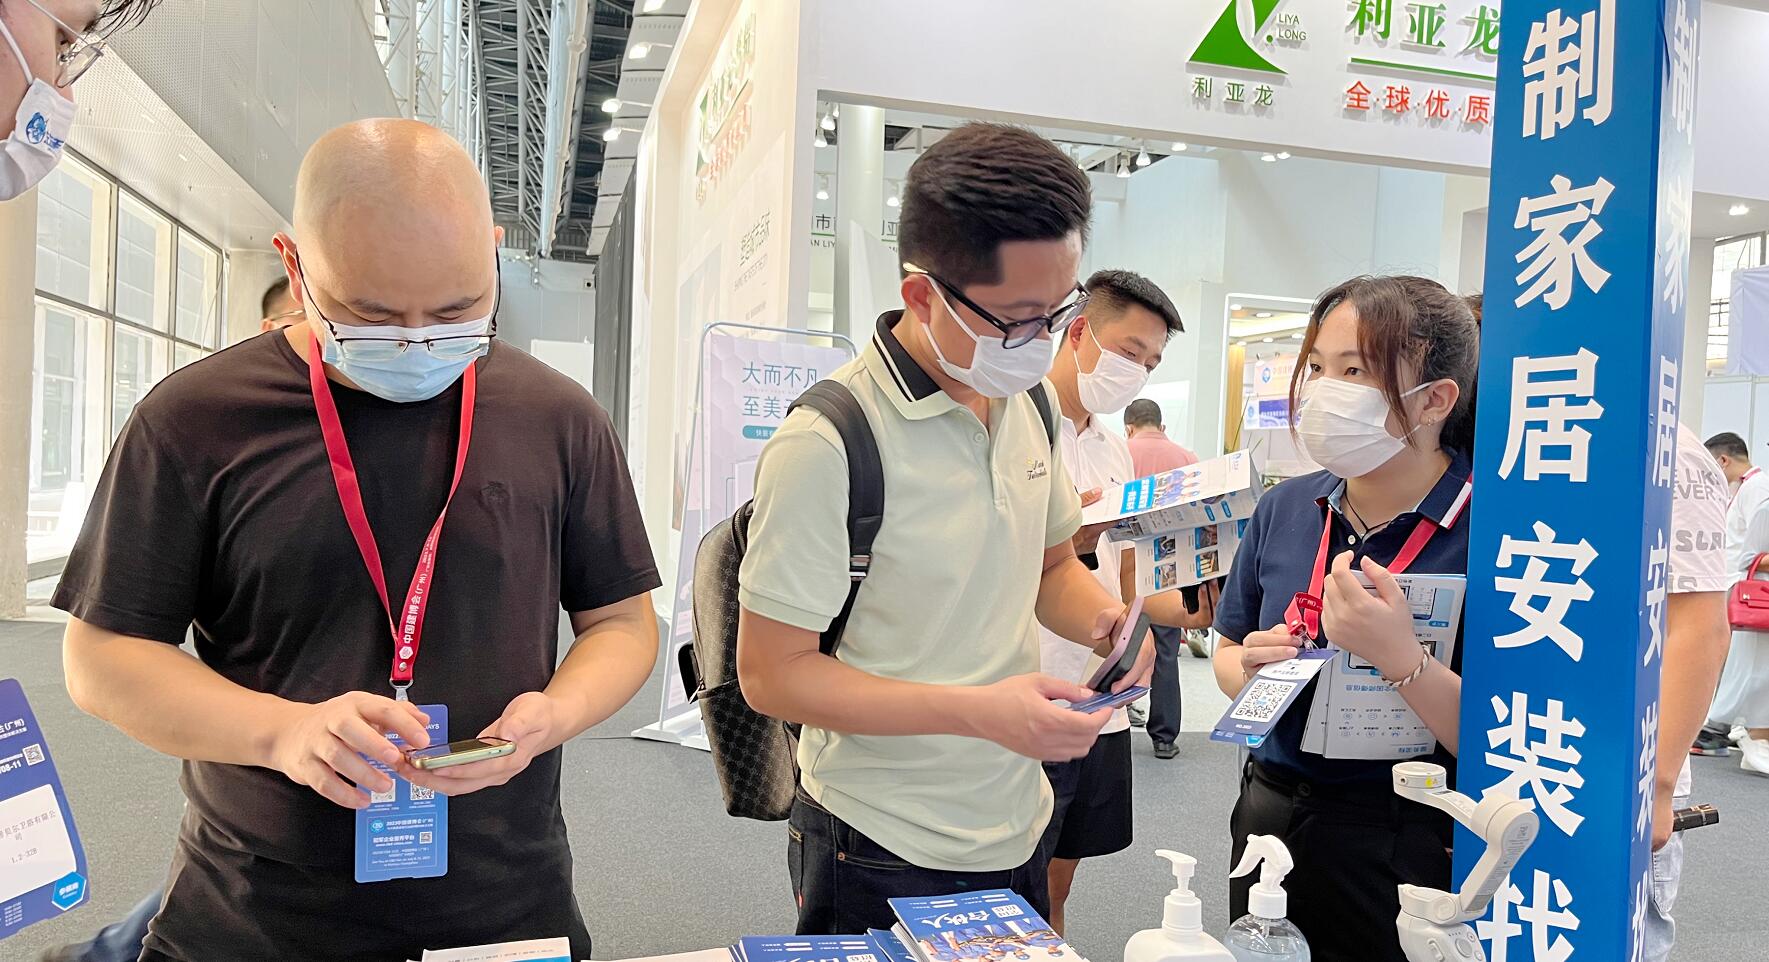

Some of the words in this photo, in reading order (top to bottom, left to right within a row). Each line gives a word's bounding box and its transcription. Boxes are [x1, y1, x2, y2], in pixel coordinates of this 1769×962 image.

[1278, 13, 1300, 26] LIYA
[1350, 0, 1499, 55] 利亚龙
[1278, 29, 1307, 42] LONG
[1193, 76, 1274, 107] 利亚龙
[742, 361, 817, 389] 大而不凡
[921, 910, 991, 929] 合伙人
